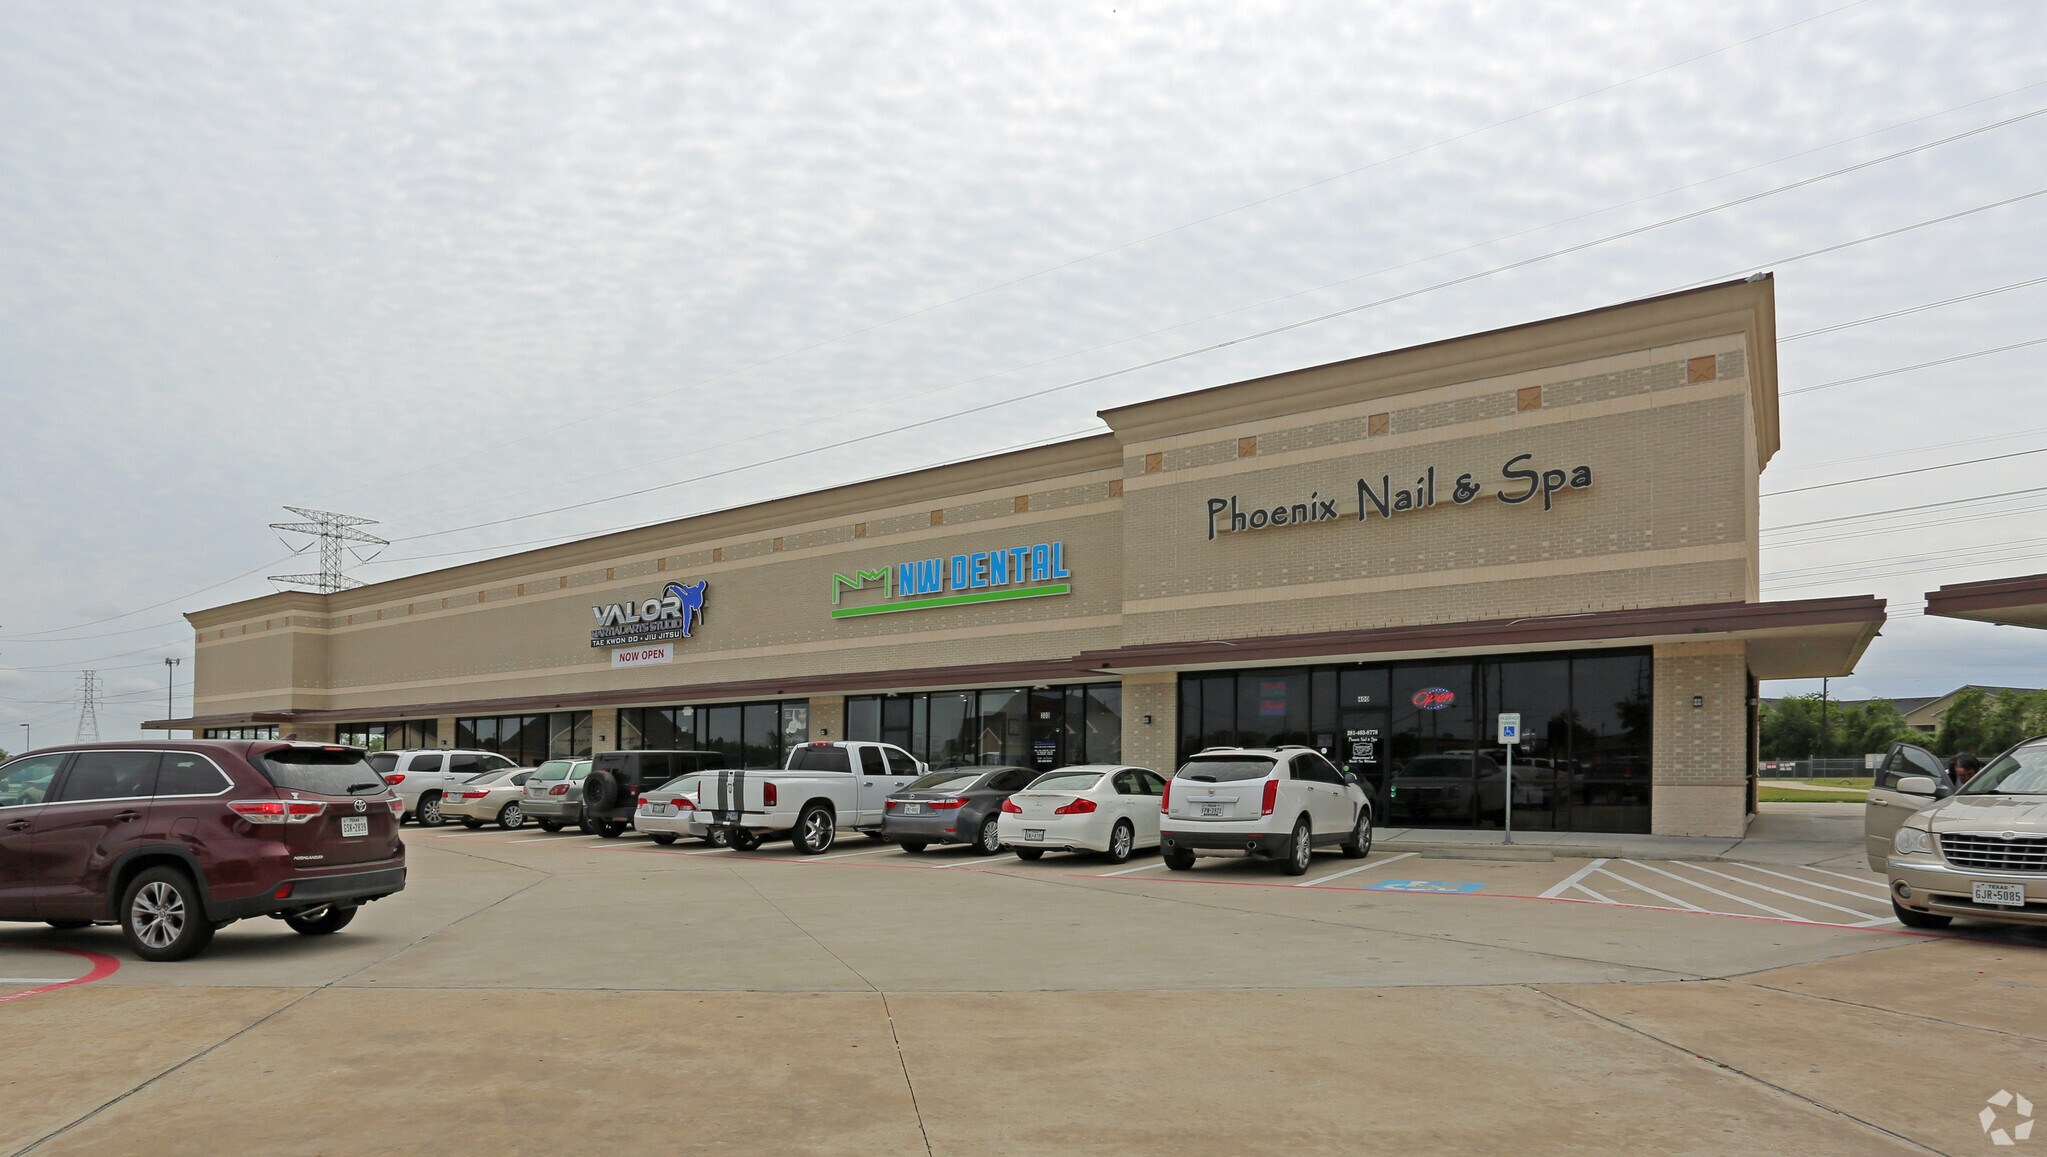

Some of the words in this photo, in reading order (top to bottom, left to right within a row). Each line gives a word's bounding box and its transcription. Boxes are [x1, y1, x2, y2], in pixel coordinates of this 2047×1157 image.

[1207, 491, 1338, 540] Phoenix
[1357, 466, 1436, 522] Nail
[1452, 473, 1481, 503] &
[1497, 453, 1593, 511] Spa
[899, 558, 943, 597] NW
[951, 541, 1071, 590] DENTAL
[592, 597, 681, 626] VALOR
[659, 630, 680, 639] JITSU
[619, 652, 640, 662] NOW
[641, 649, 665, 660] OPEN
[1413, 691, 1454, 705] Open
[1975, 889, 2021, 901] GJR-5085
